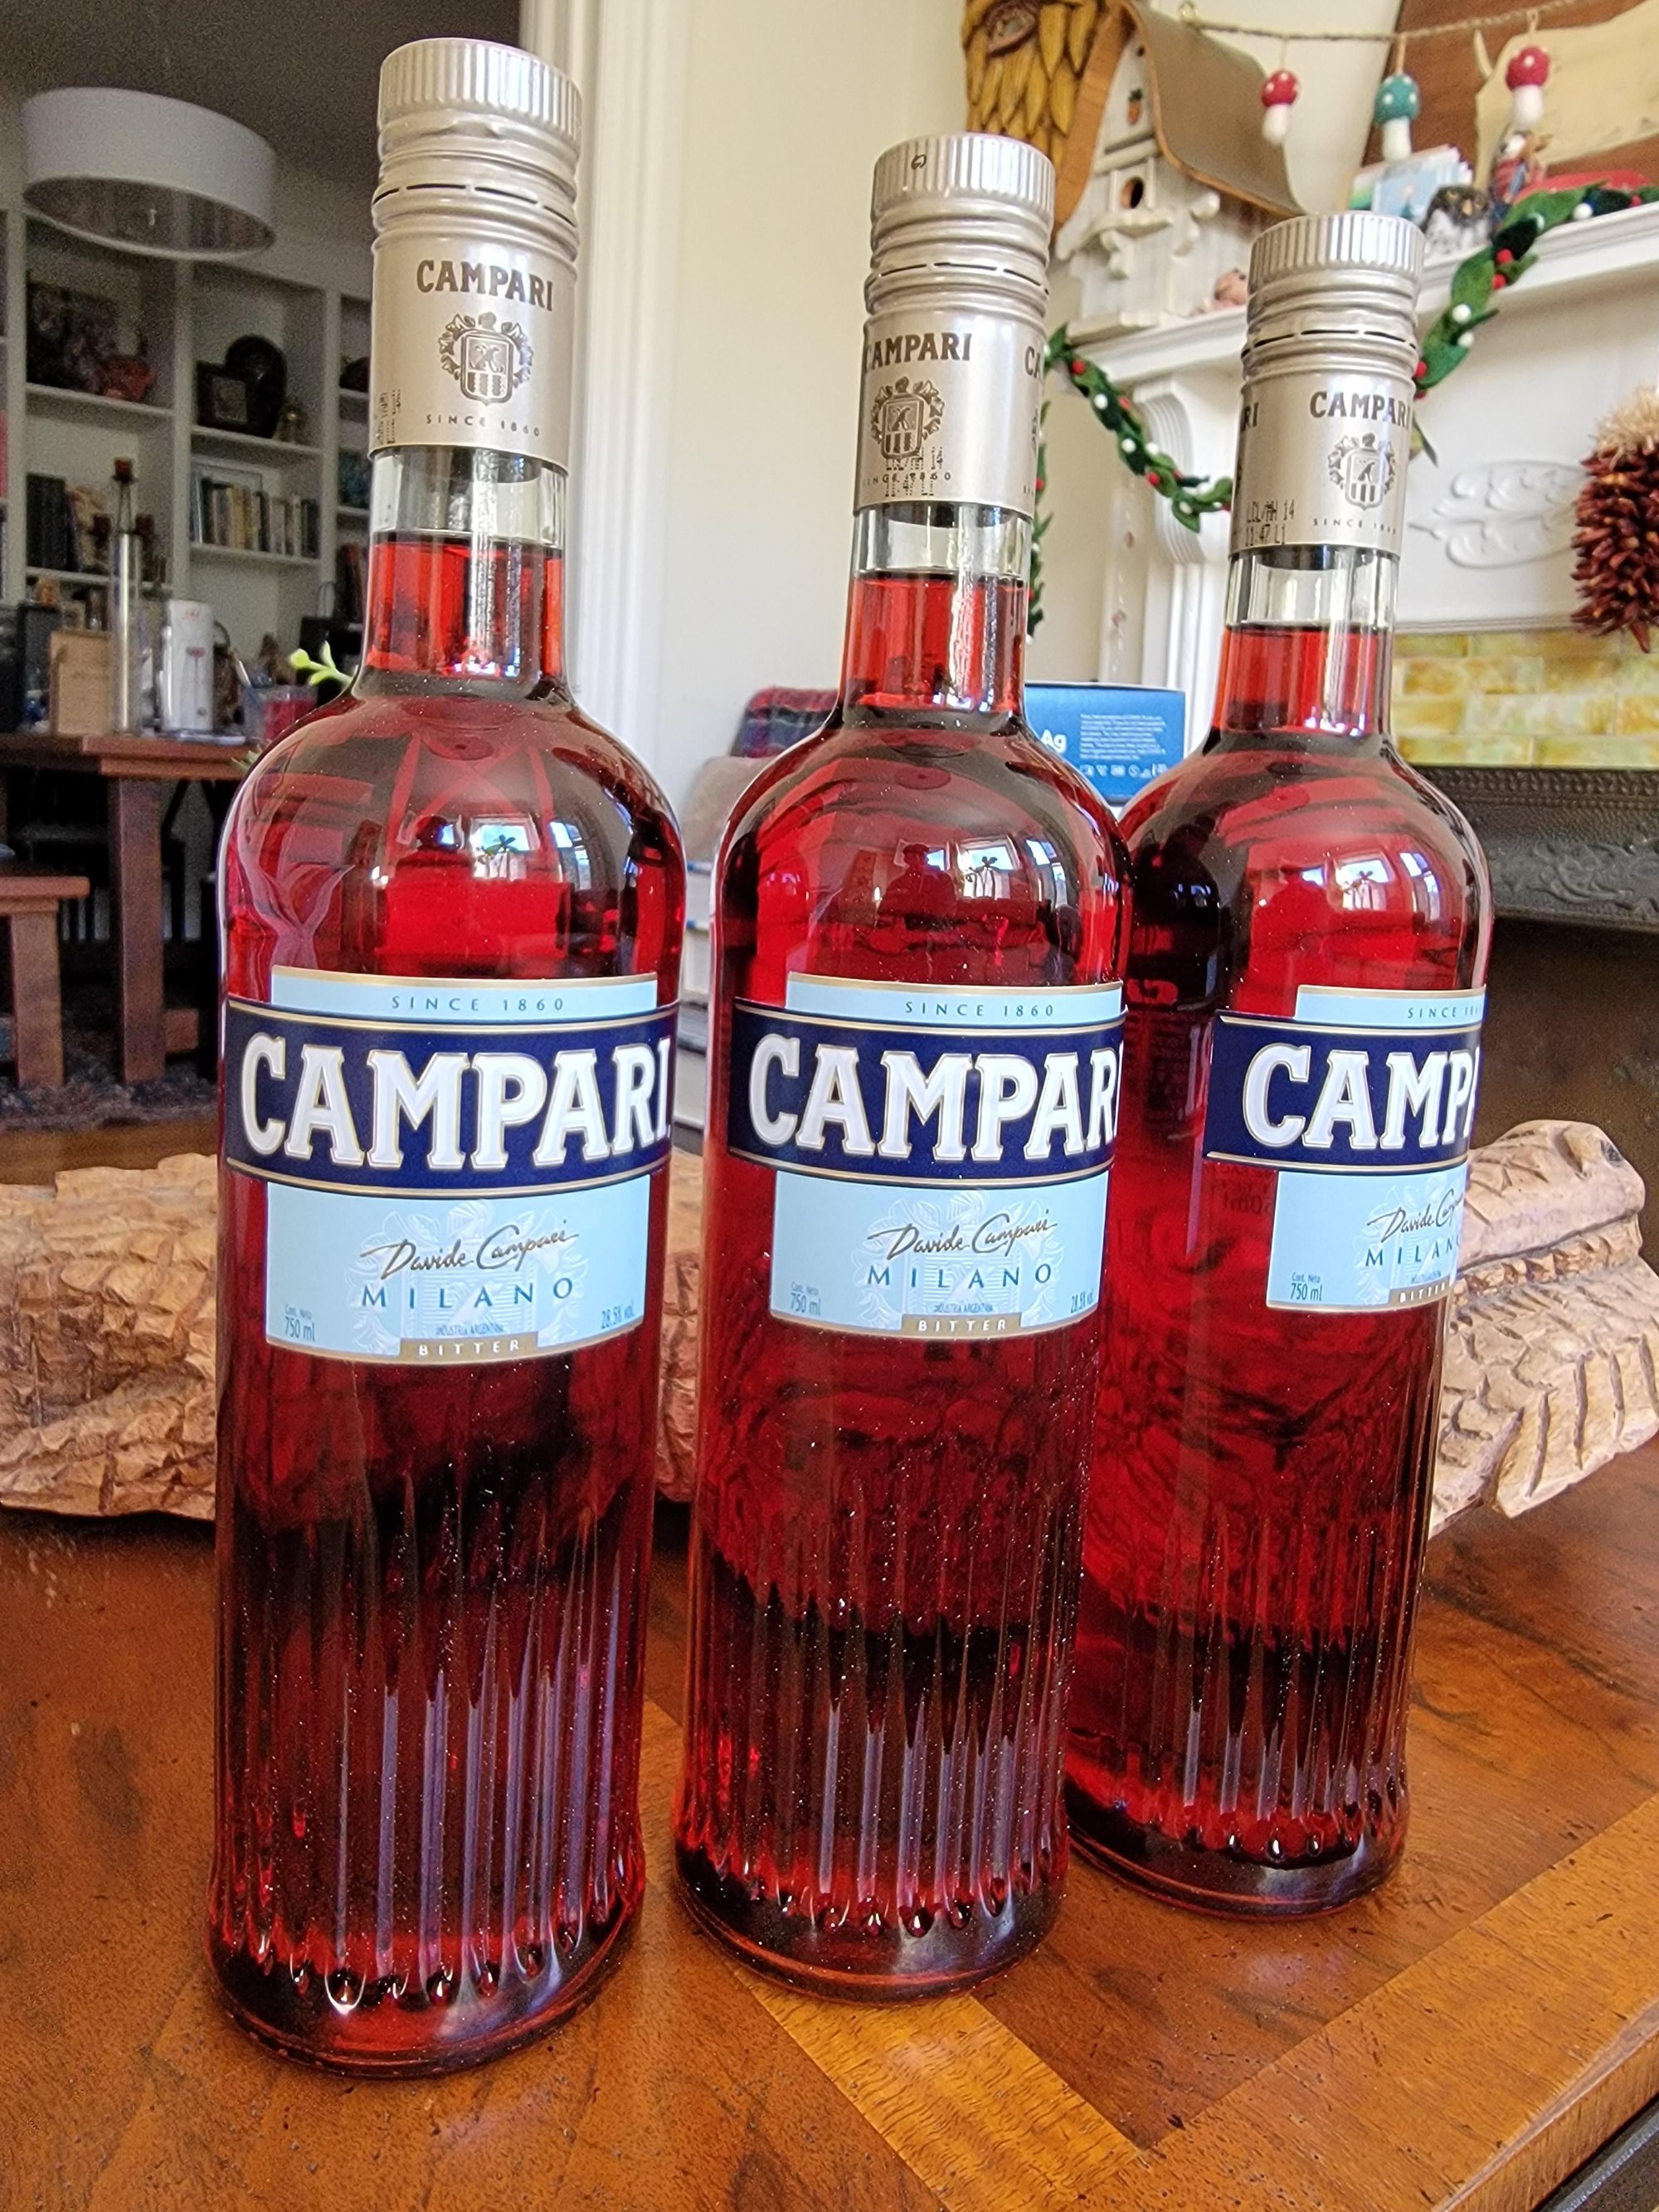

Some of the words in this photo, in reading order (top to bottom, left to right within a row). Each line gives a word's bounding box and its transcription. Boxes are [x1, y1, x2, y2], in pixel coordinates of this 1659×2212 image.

[416, 260, 553, 312] CAMPARI
[1310, 391, 1410, 430] CAMPARI
[426, 414, 486, 427] SINCE
[501, 420, 540, 437] 1860
[1313, 518, 1363, 529] SINCE
[392, 996, 480, 1012] SINCE
[503, 997, 566, 1012] 1860
[905, 1001, 985, 1016] SINCE
[1003, 1003, 1055, 1017] 1860
[1407, 1006, 1457, 1020] SINCE
[241, 1031, 671, 1171] CAMPARI
[748, 1033, 1125, 1162] CAMPAR
[867, 1221, 971, 1260] Davide
[360, 1238, 474, 1279] Davide
[867, 1263, 1053, 1288] MILANO
[362, 1277, 574, 1309] MILANO
[791, 1292, 806, 1313] 750
[1290, 1282, 1308, 1301] 750
[1310, 1284, 1322, 1302] ml
[285, 1315, 300, 1338] 750
[304, 1322, 315, 1342] ml
[917, 1319, 1006, 1332] BITTER
[418, 1339, 519, 1356] BITTER
